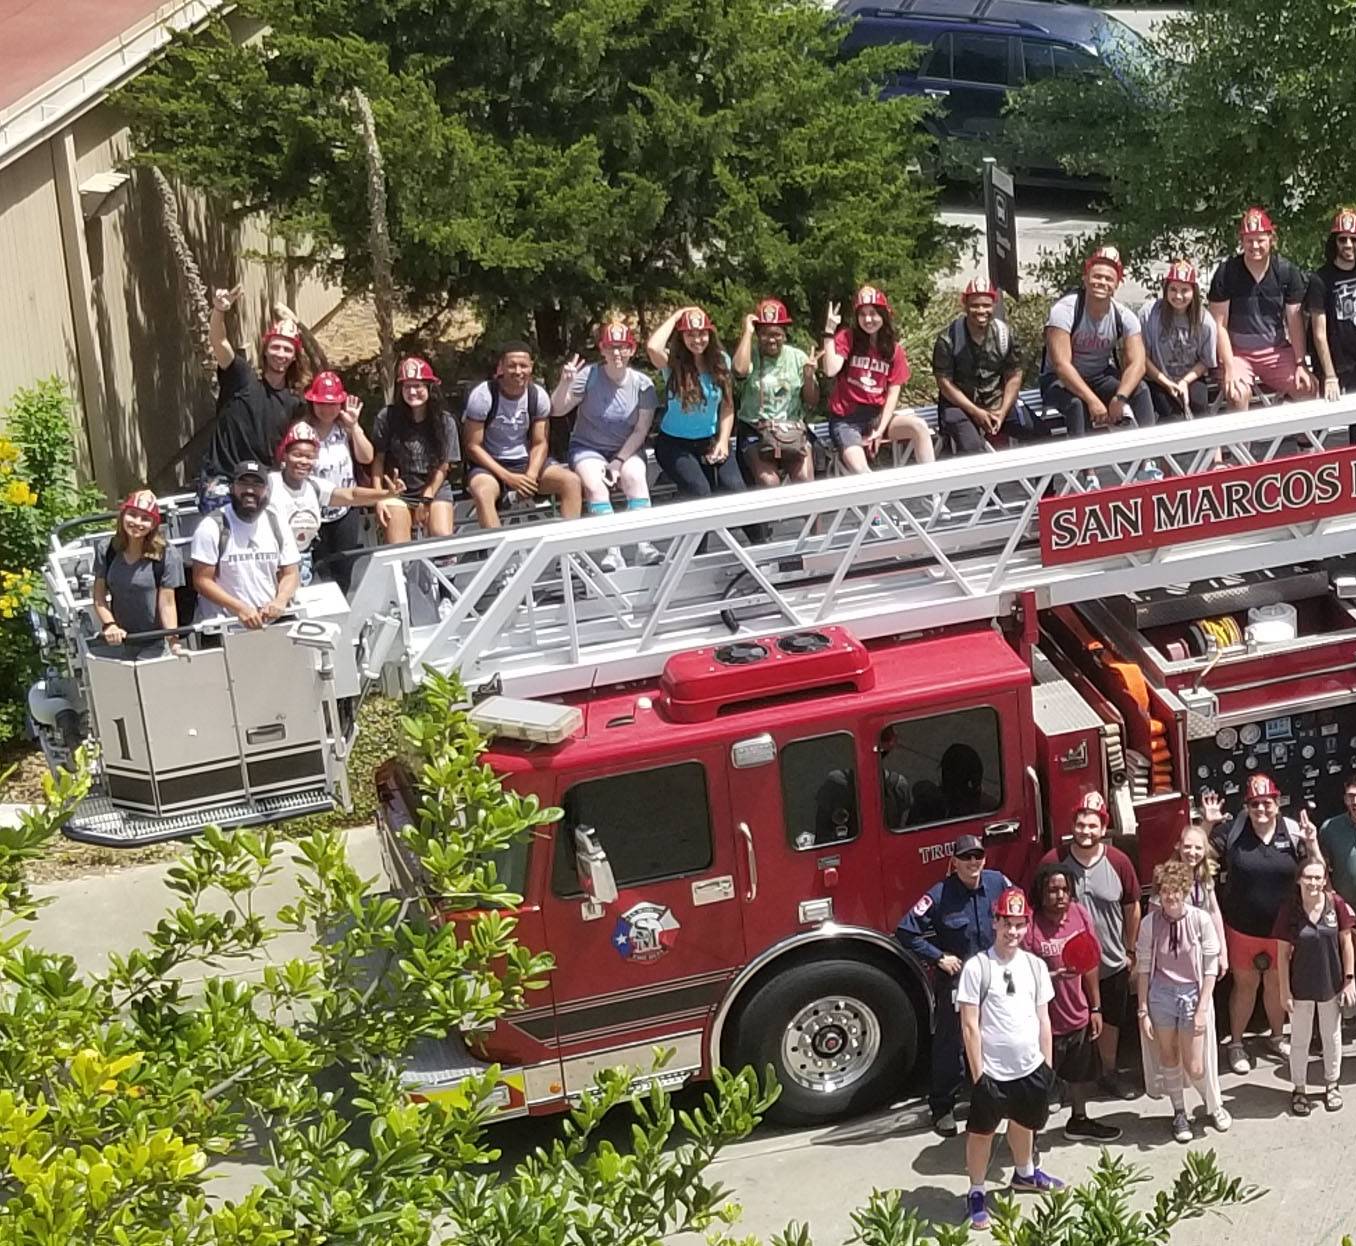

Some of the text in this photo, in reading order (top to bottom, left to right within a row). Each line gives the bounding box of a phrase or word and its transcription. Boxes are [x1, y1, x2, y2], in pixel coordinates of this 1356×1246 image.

[1051, 497, 1142, 549] SAN
[1153, 468, 1342, 533] MARCOS
[918, 841, 957, 865] TRU
